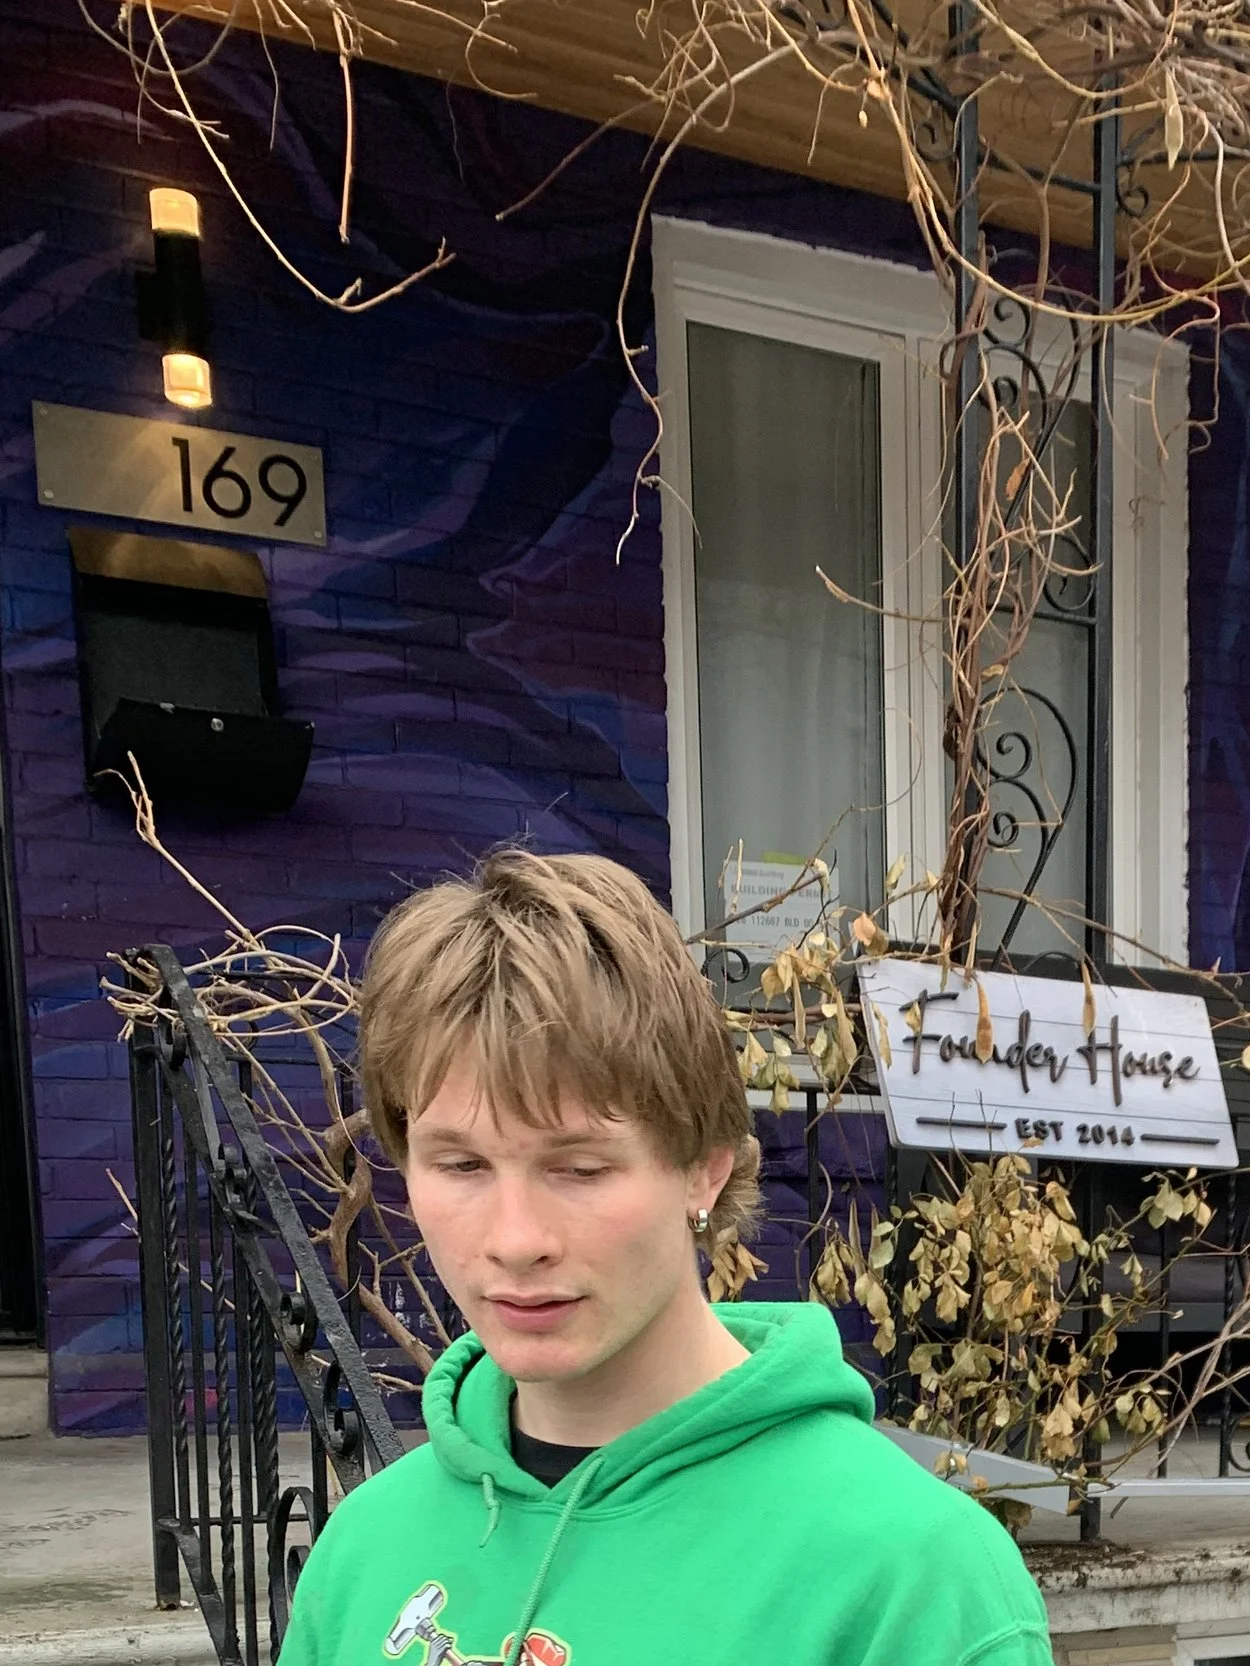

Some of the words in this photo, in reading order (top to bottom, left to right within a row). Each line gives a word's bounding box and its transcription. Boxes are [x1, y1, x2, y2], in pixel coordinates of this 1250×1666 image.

[172, 436, 308, 527] 169
[1075, 1014, 1201, 1107] House
[1013, 1117, 1065, 1142] EST
[1075, 1122, 1136, 1147] 2014
